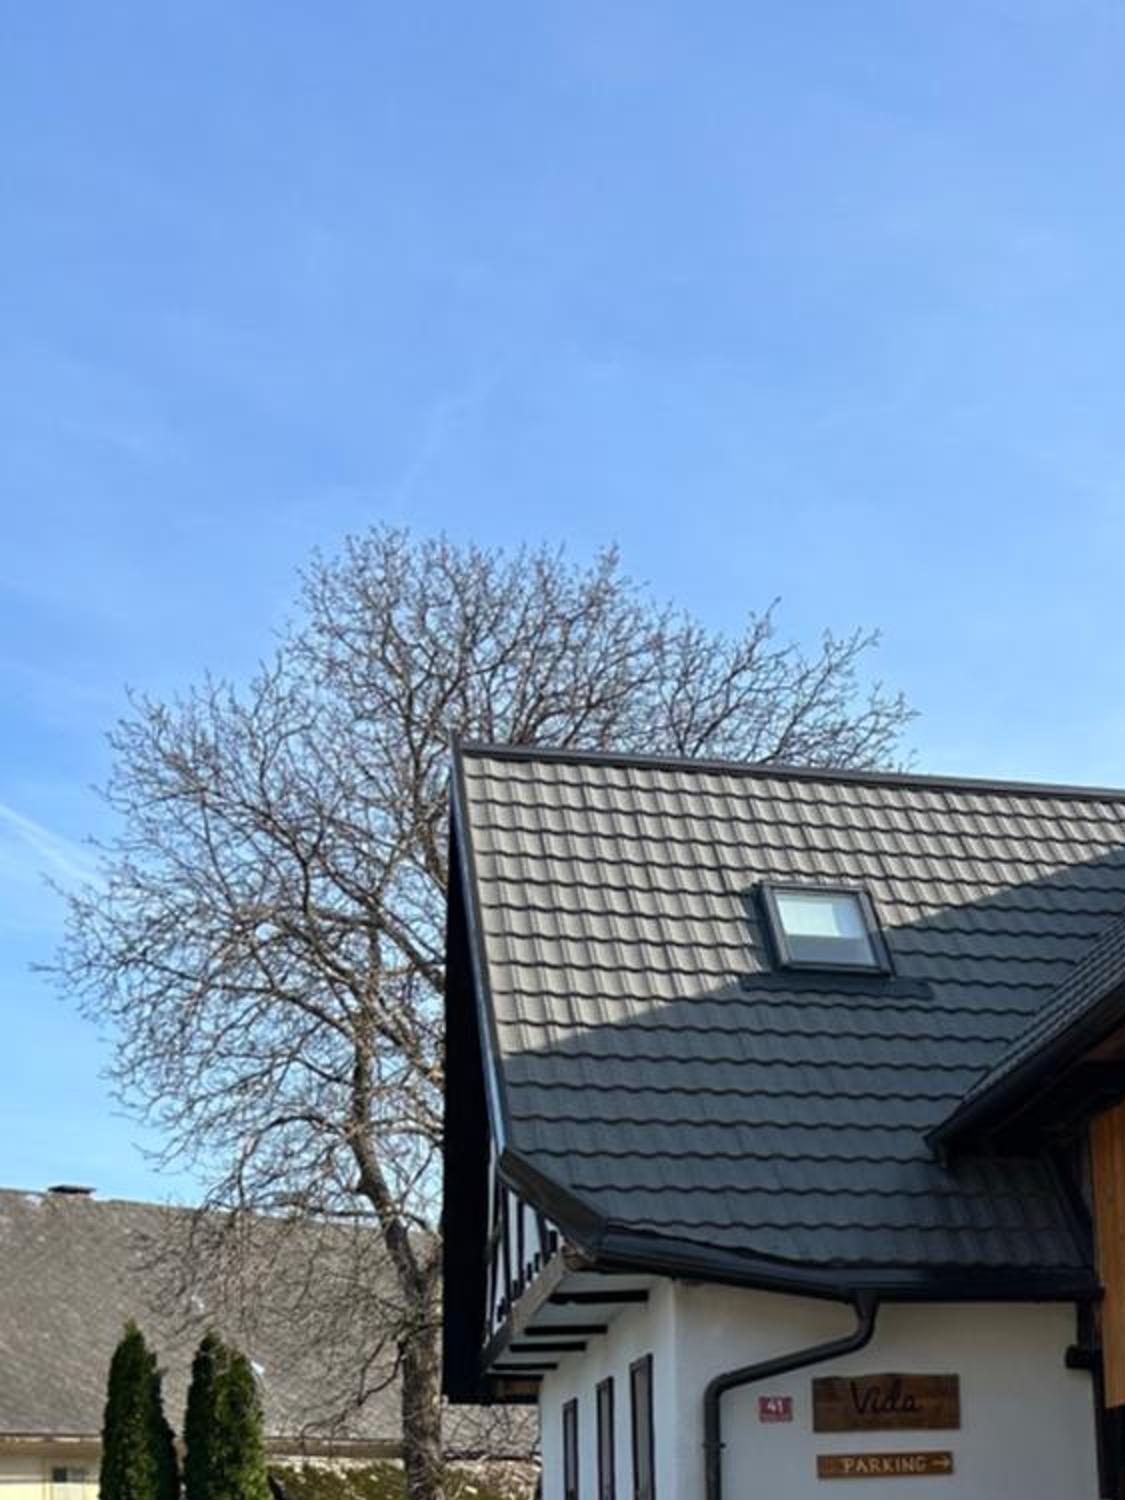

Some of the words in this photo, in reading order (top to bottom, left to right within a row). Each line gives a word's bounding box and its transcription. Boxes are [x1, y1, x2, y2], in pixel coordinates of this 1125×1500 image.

[849, 1377, 921, 1415] Vida
[767, 1399, 783, 1414] 41
[840, 1455, 928, 1474] PARKING
